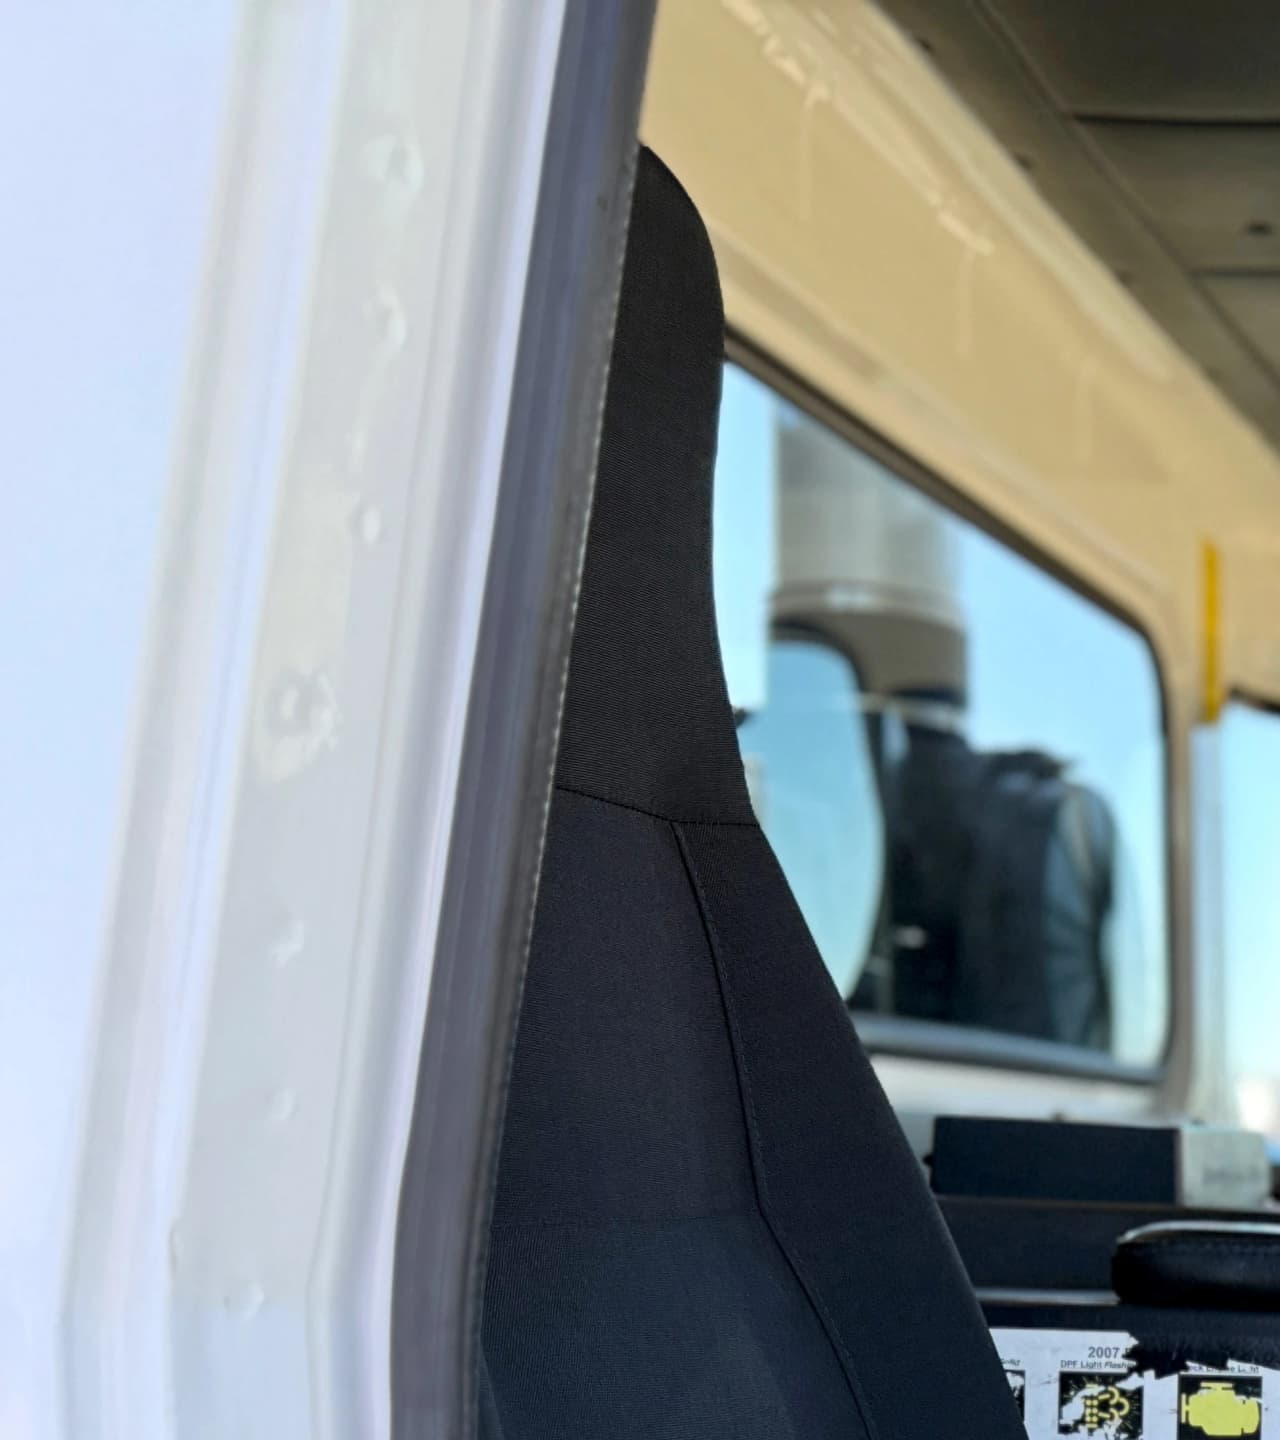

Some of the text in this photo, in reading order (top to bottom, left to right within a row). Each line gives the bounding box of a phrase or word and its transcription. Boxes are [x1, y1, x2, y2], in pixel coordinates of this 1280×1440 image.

[1088, 1346, 1120, 1359] 2007
[1060, 1359, 1078, 1368] DPF
[1081, 1360, 1102, 1369] Light
